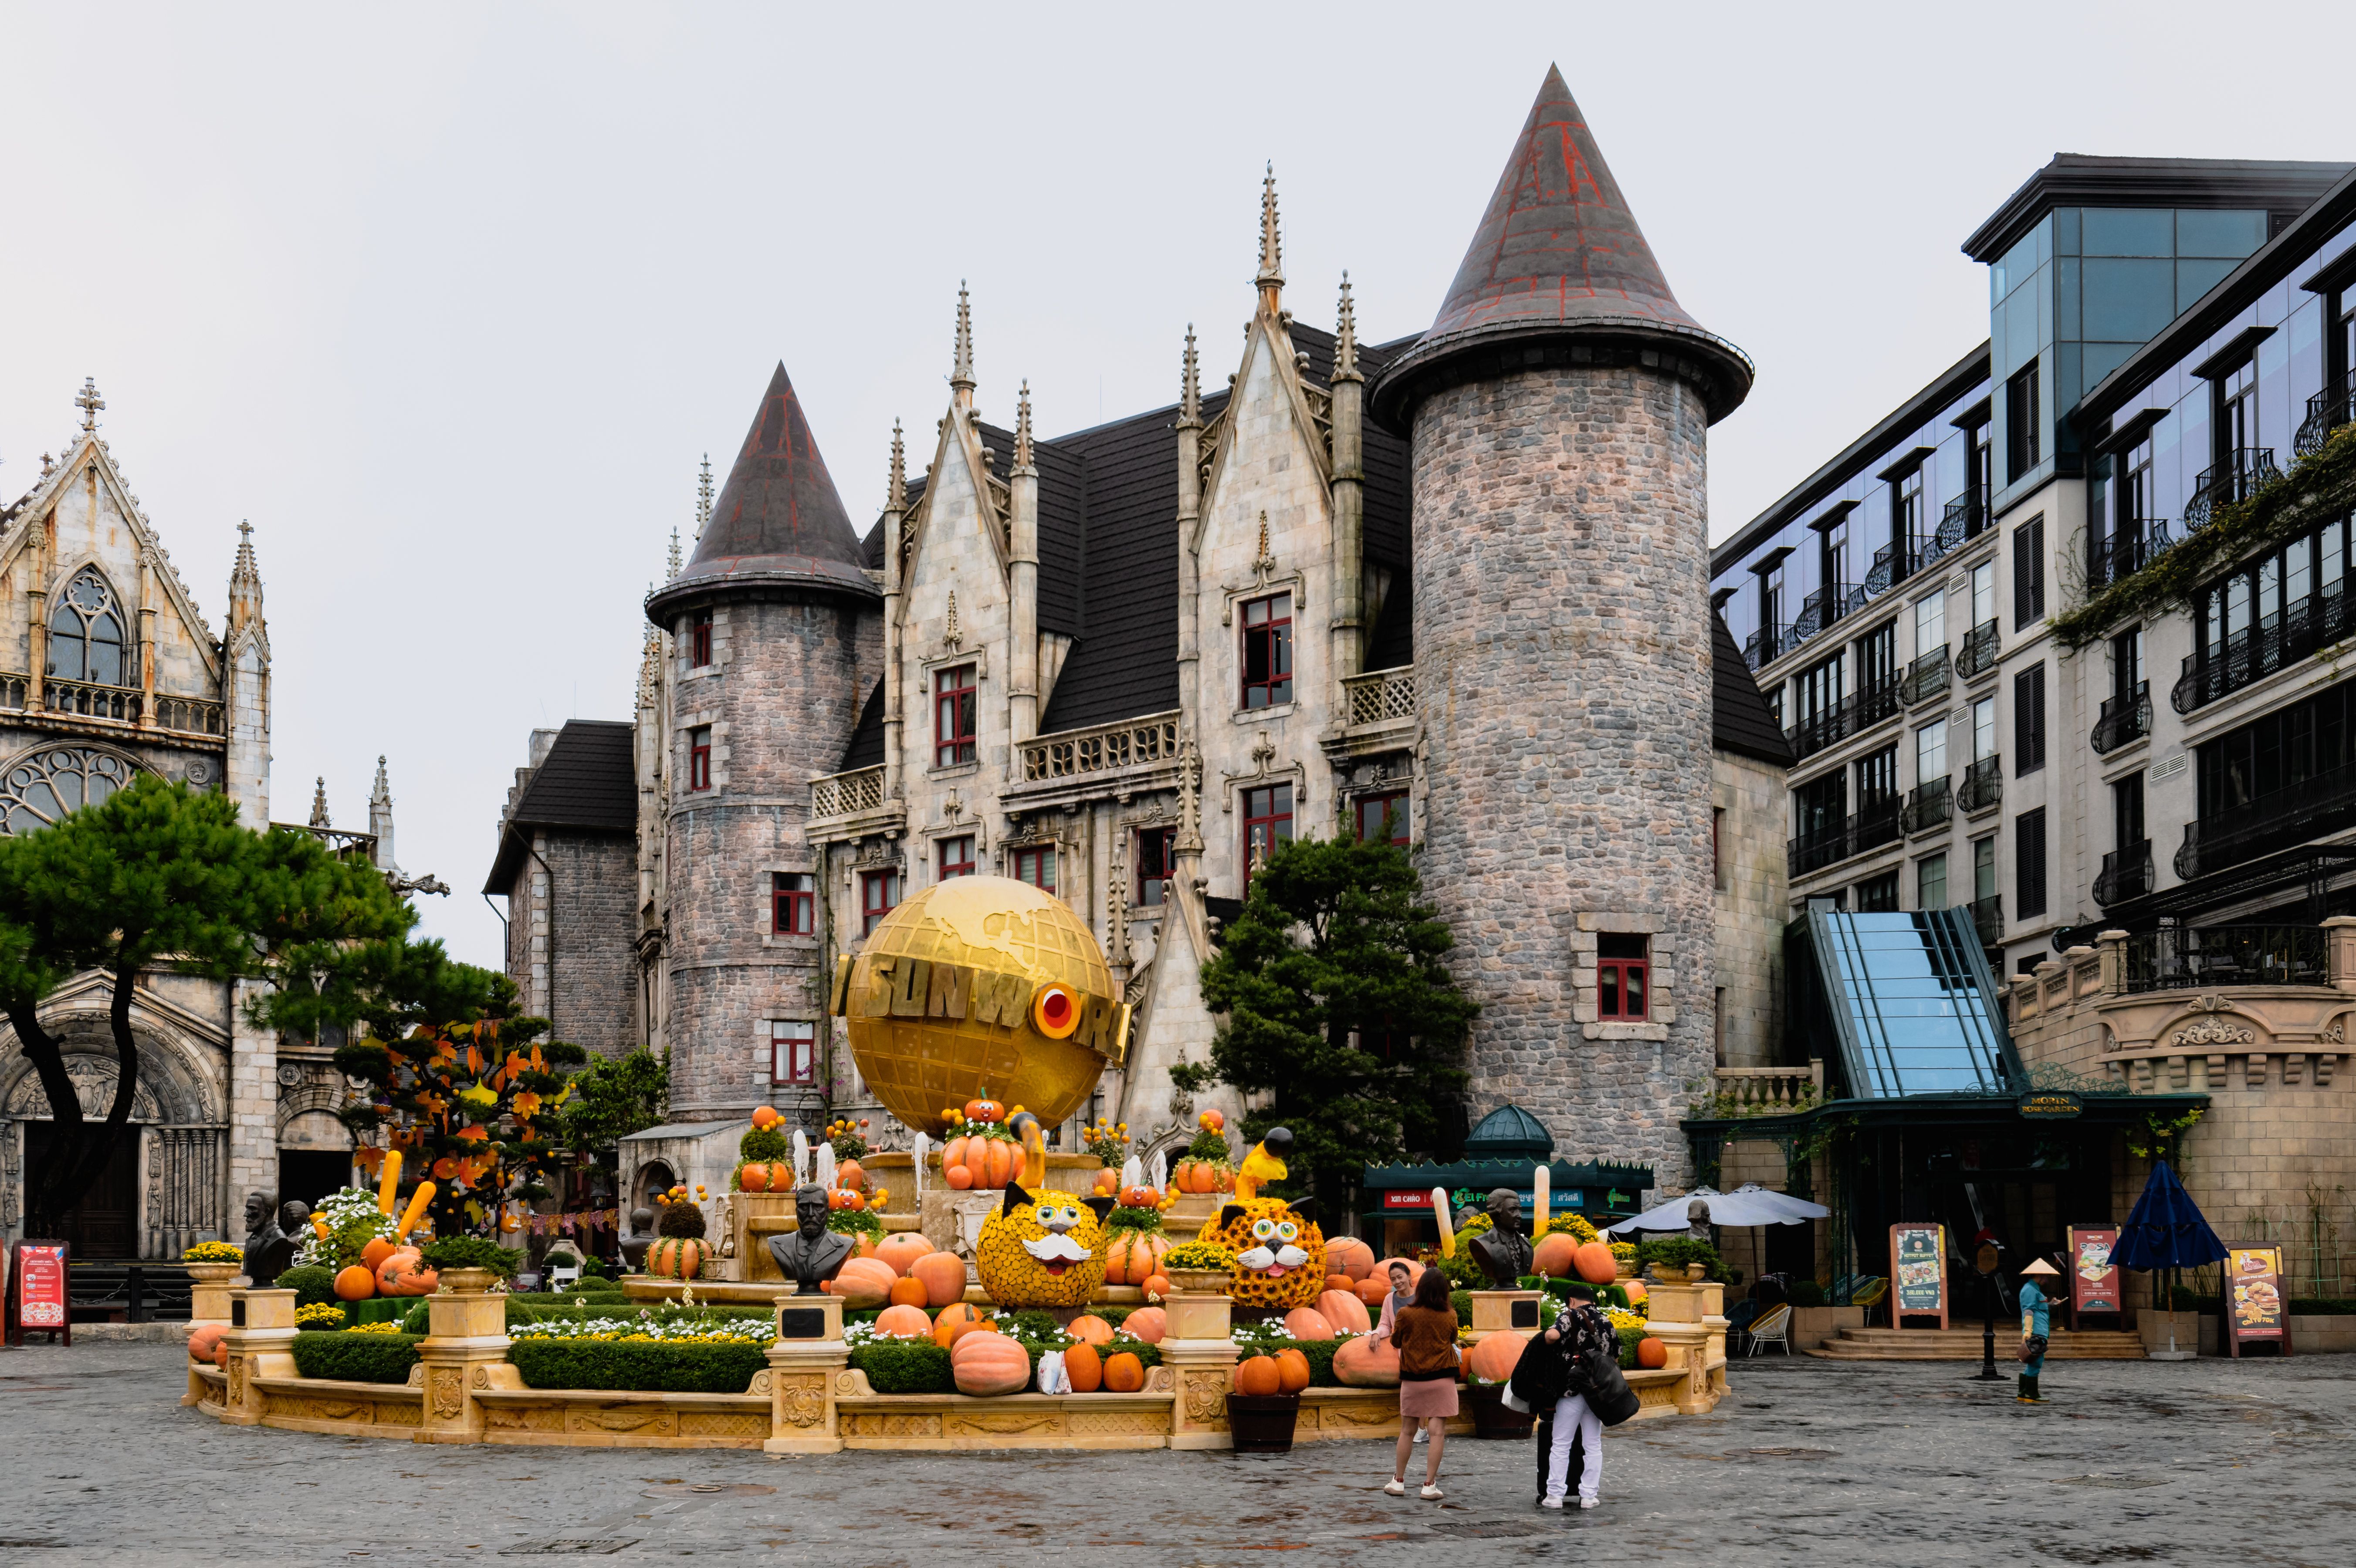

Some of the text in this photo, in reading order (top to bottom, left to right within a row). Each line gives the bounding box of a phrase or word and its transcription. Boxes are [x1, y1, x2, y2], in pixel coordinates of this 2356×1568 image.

[863, 952, 1132, 1067] SUN WORL
[1465, 1193, 1489, 1202] El Fr
[2080, 1243, 2112, 1251] ROSA
